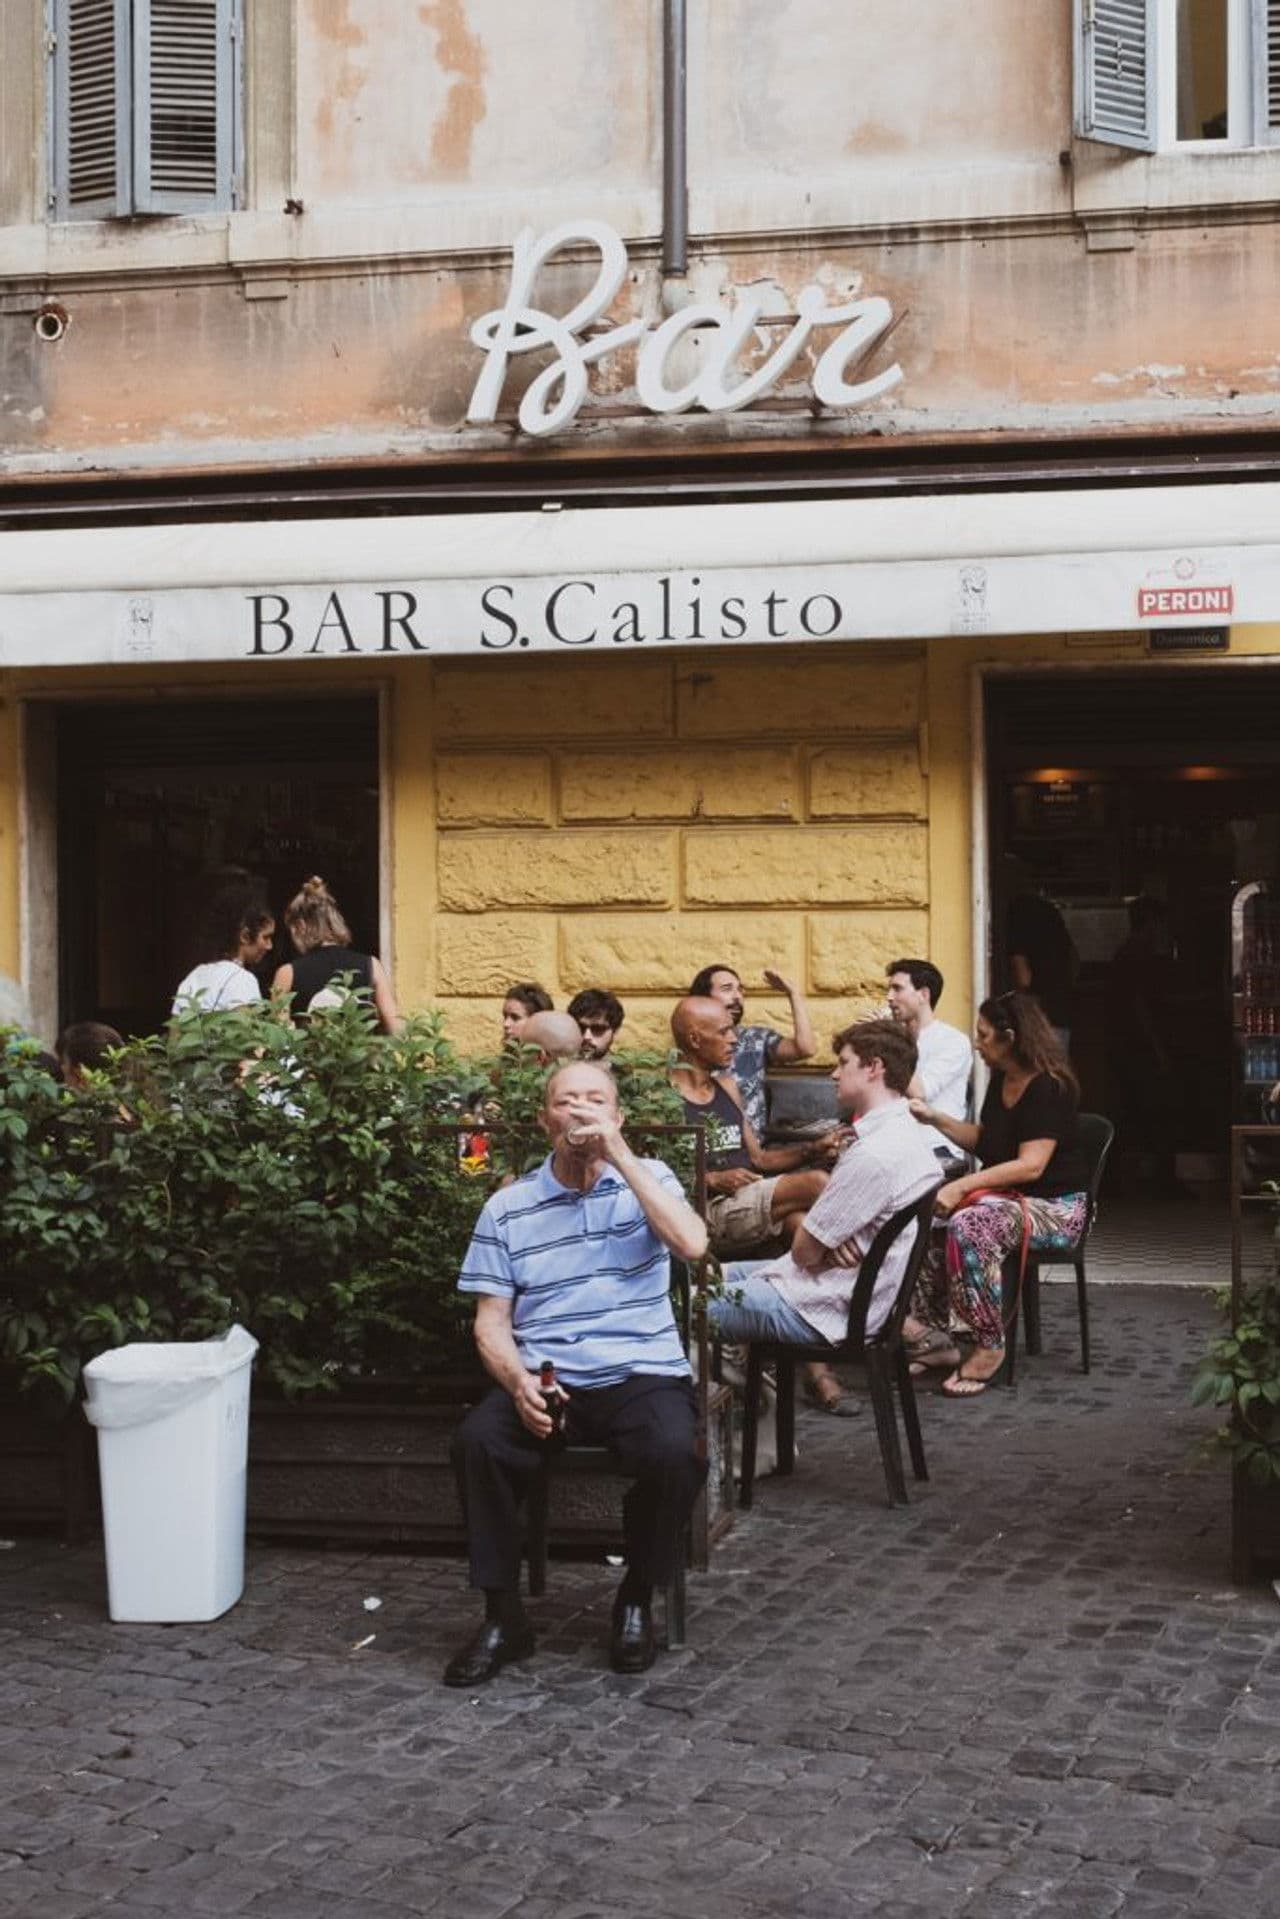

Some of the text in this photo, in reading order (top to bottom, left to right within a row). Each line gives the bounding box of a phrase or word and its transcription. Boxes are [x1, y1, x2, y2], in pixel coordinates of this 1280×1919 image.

[467, 219, 904, 437] Bar
[245, 591, 430, 655] BAR
[1142, 591, 1229, 611] PERONI
